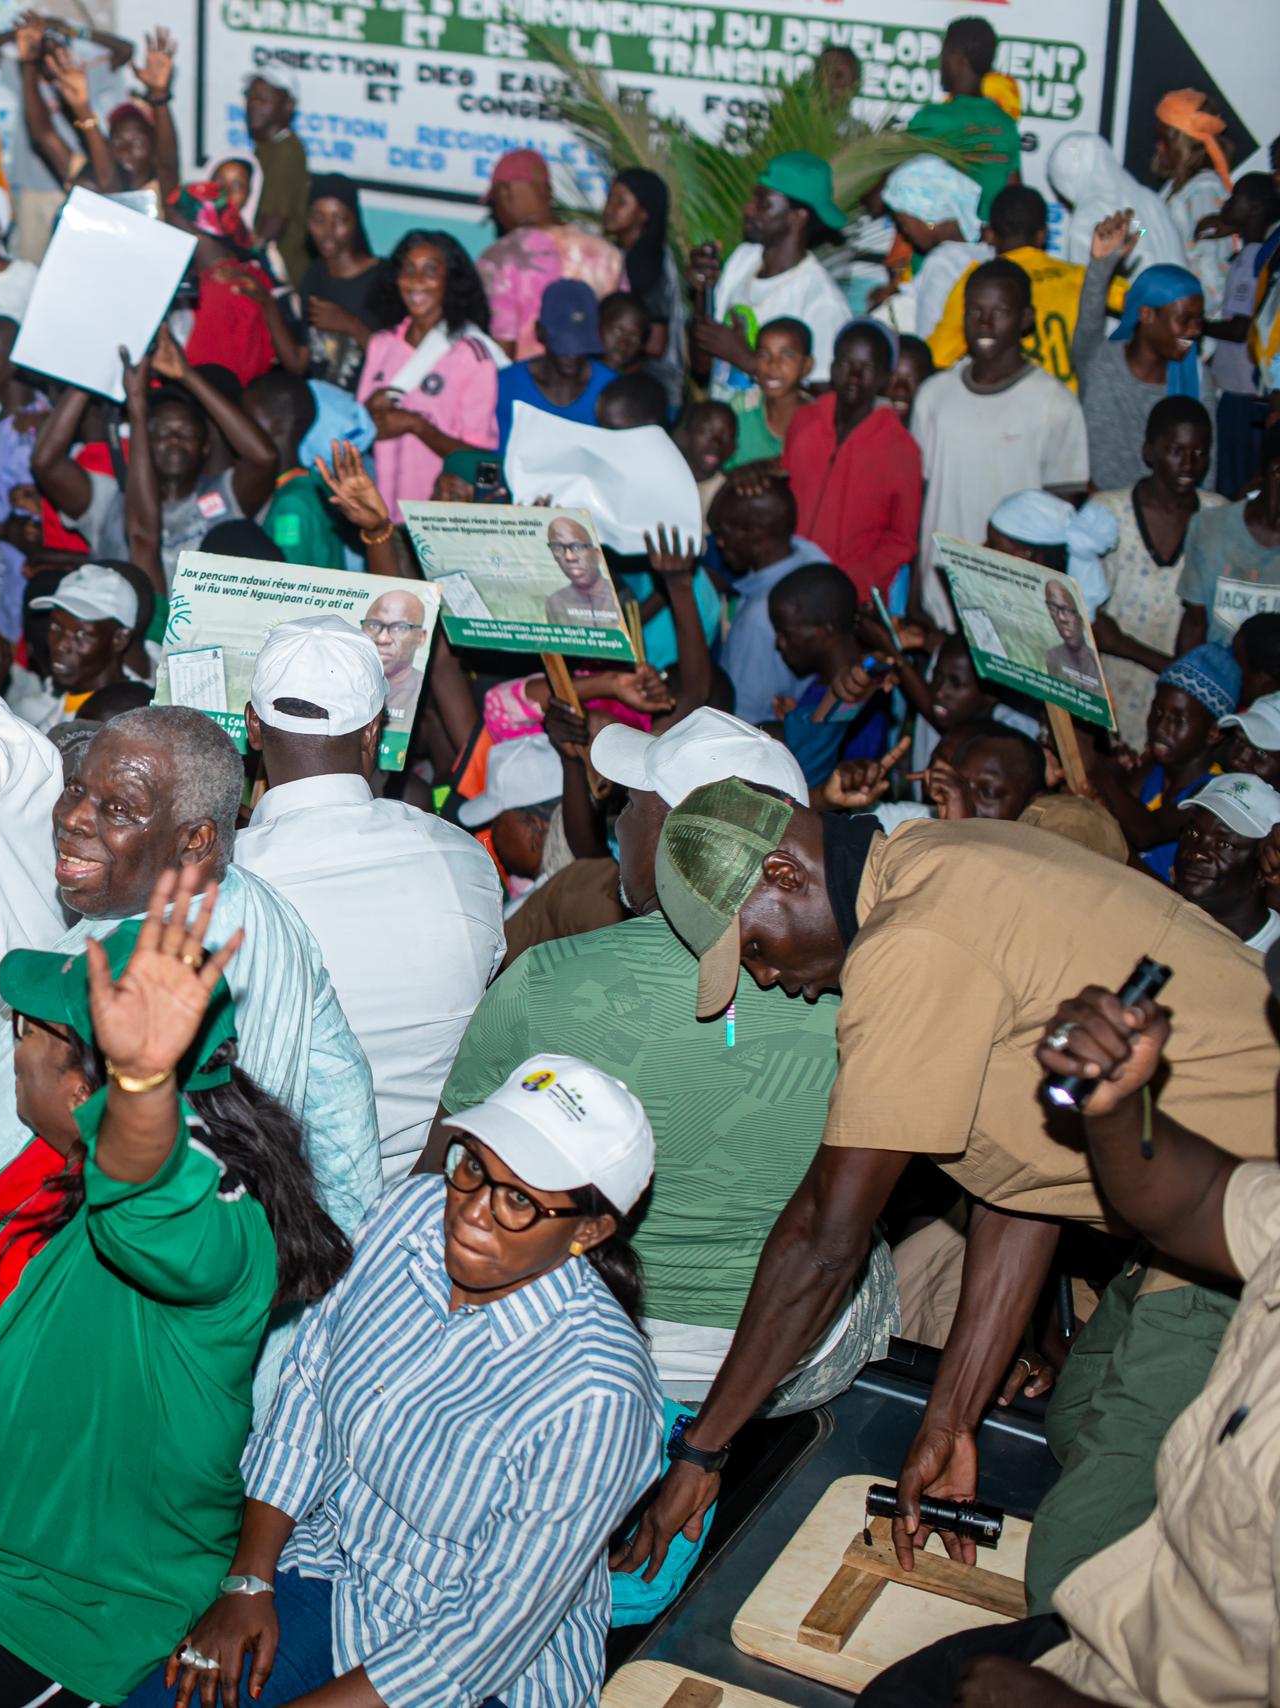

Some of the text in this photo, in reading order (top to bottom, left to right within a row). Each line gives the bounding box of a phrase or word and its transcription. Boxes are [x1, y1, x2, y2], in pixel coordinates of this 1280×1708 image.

[402, 13, 447, 49] ET
[483, 22, 529, 58] DE
[568, 30, 613, 67] LA
[723, 12, 771, 46] DU
[367, 82, 402, 104] ET
[181, 567, 198, 579] Jox
[199, 569, 239, 584] pencum
[240, 575, 272, 588] ndawi
[272, 577, 296, 591] réew
[297, 581, 312, 591] mi
[311, 585, 335, 596] sunu
[194, 582, 354, 611] wi ñu woné Nguunjaan ci ay ati at
